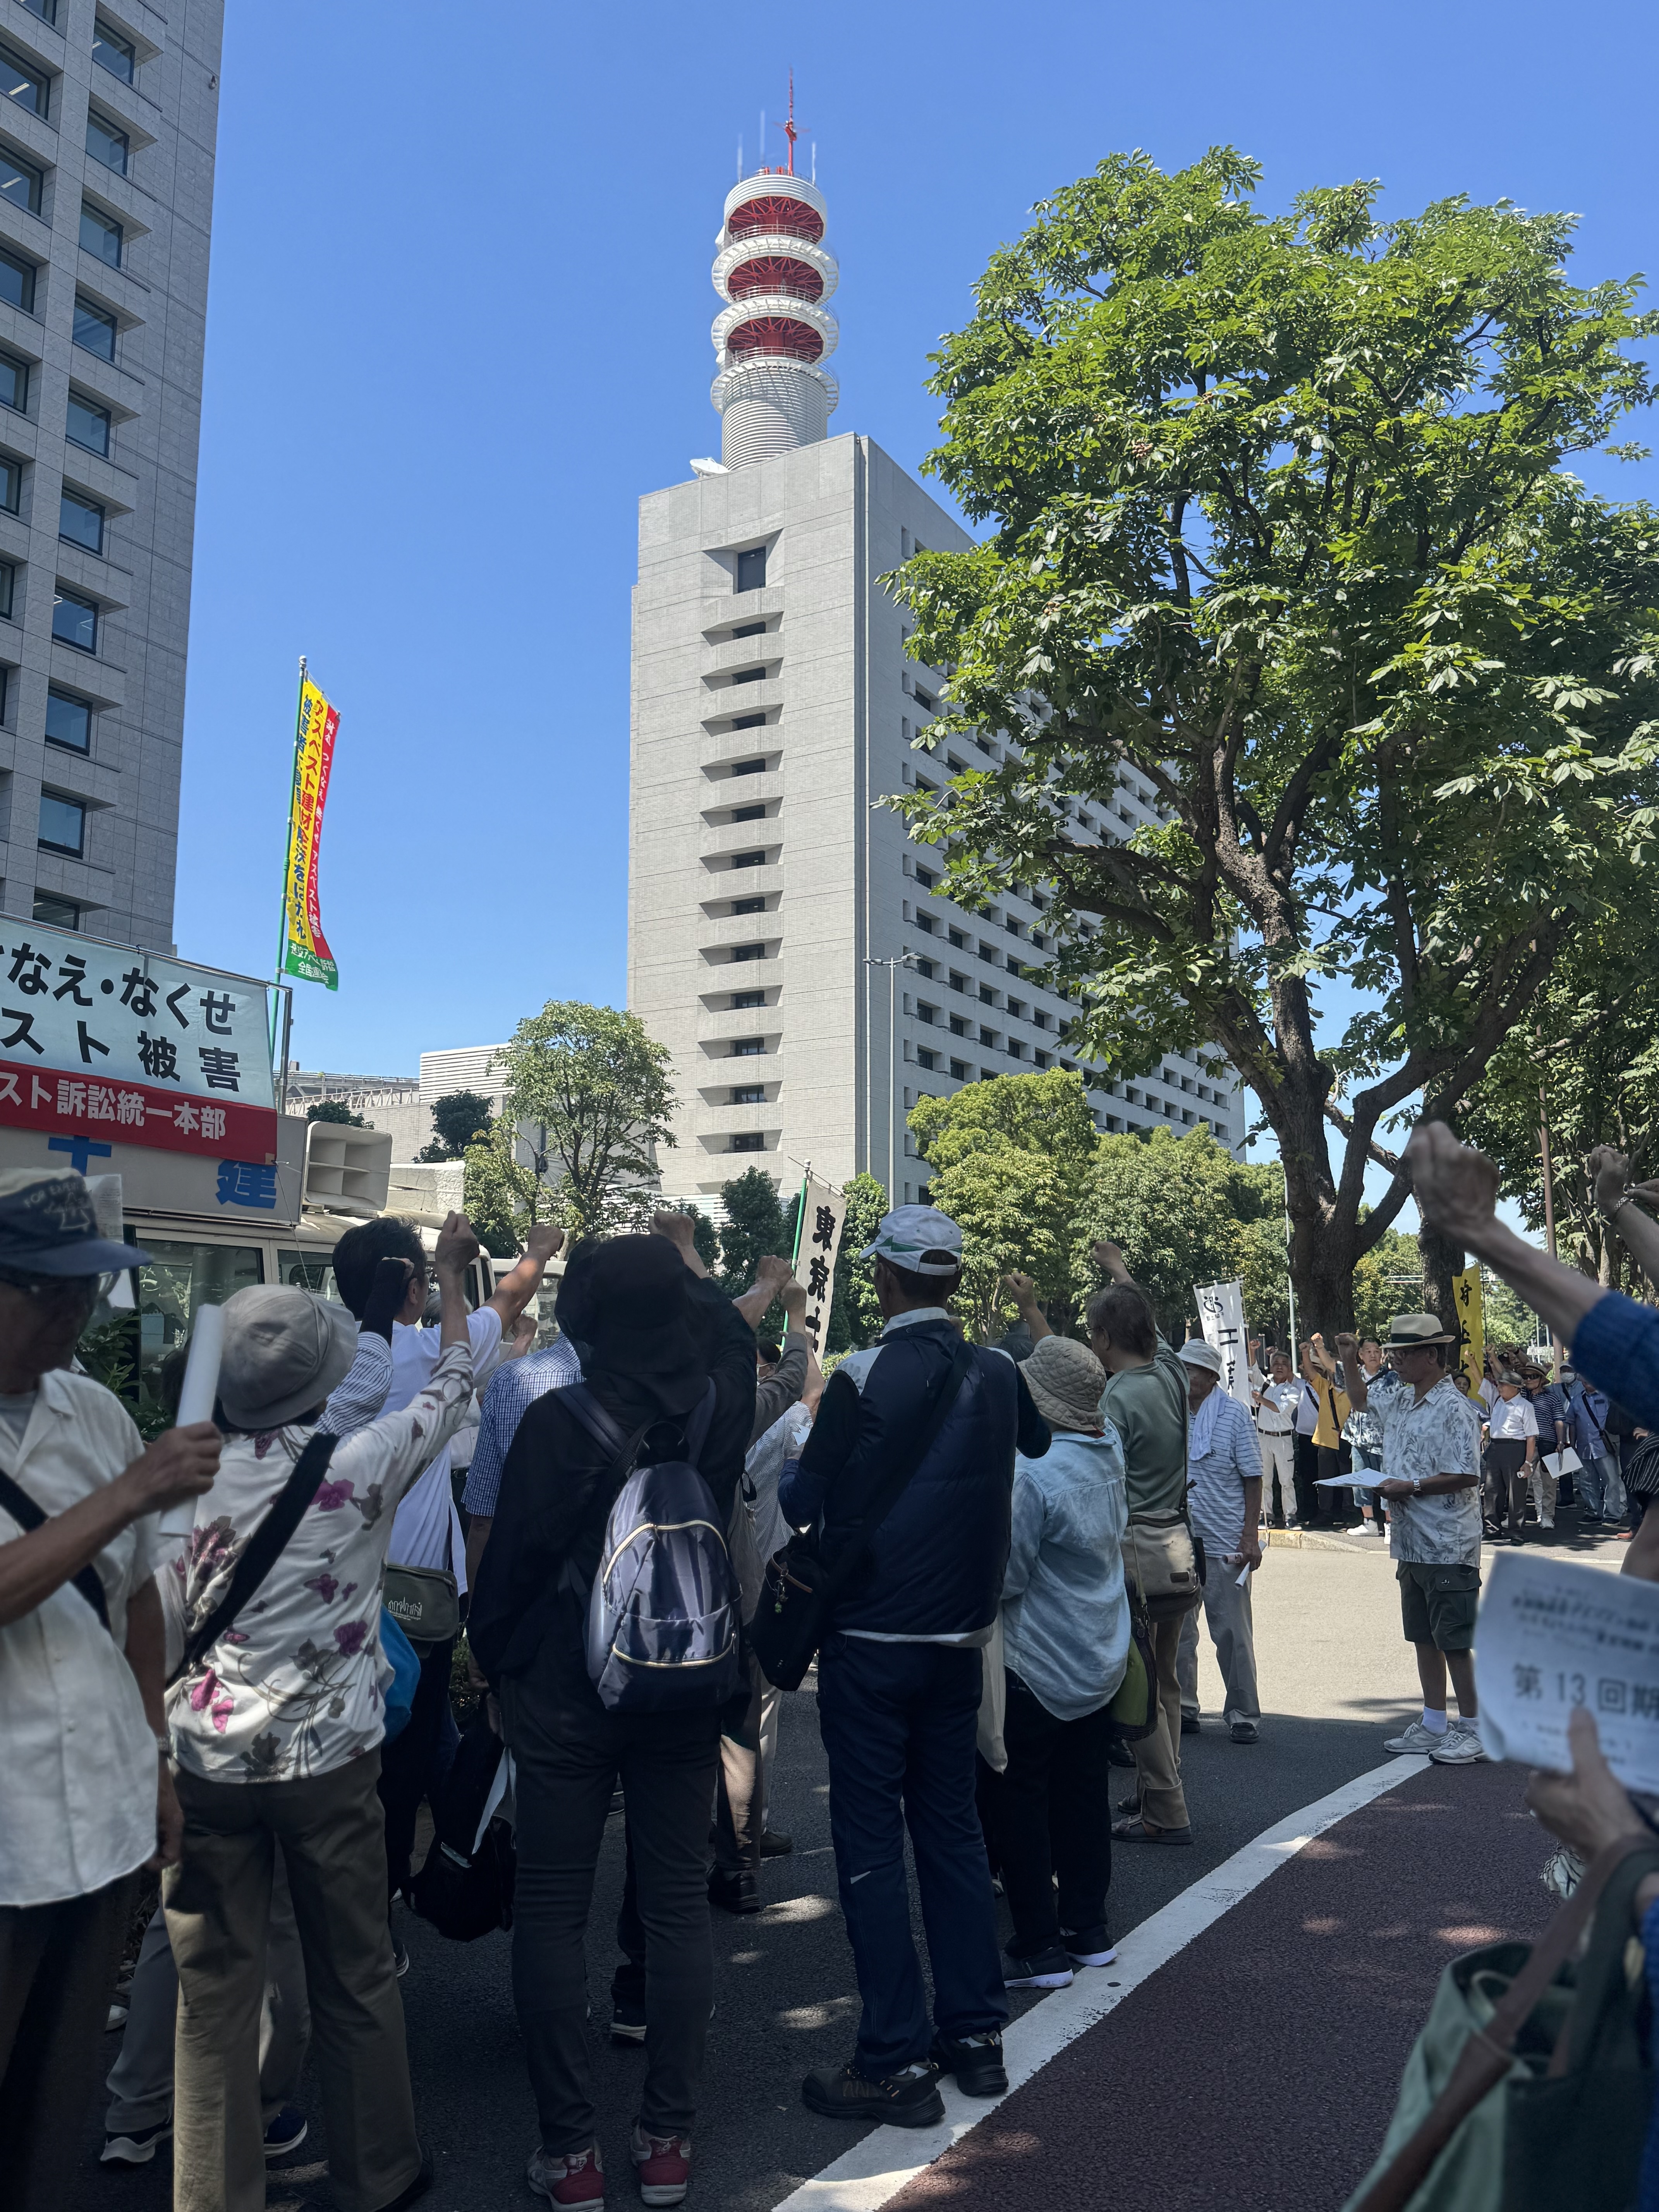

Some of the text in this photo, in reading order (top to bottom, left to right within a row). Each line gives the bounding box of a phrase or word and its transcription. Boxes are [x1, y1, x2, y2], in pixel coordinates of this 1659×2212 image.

[0, 943, 236, 1035] なえ・なくせ
[0, 1072, 226, 1140] スト訴訟統一本部
